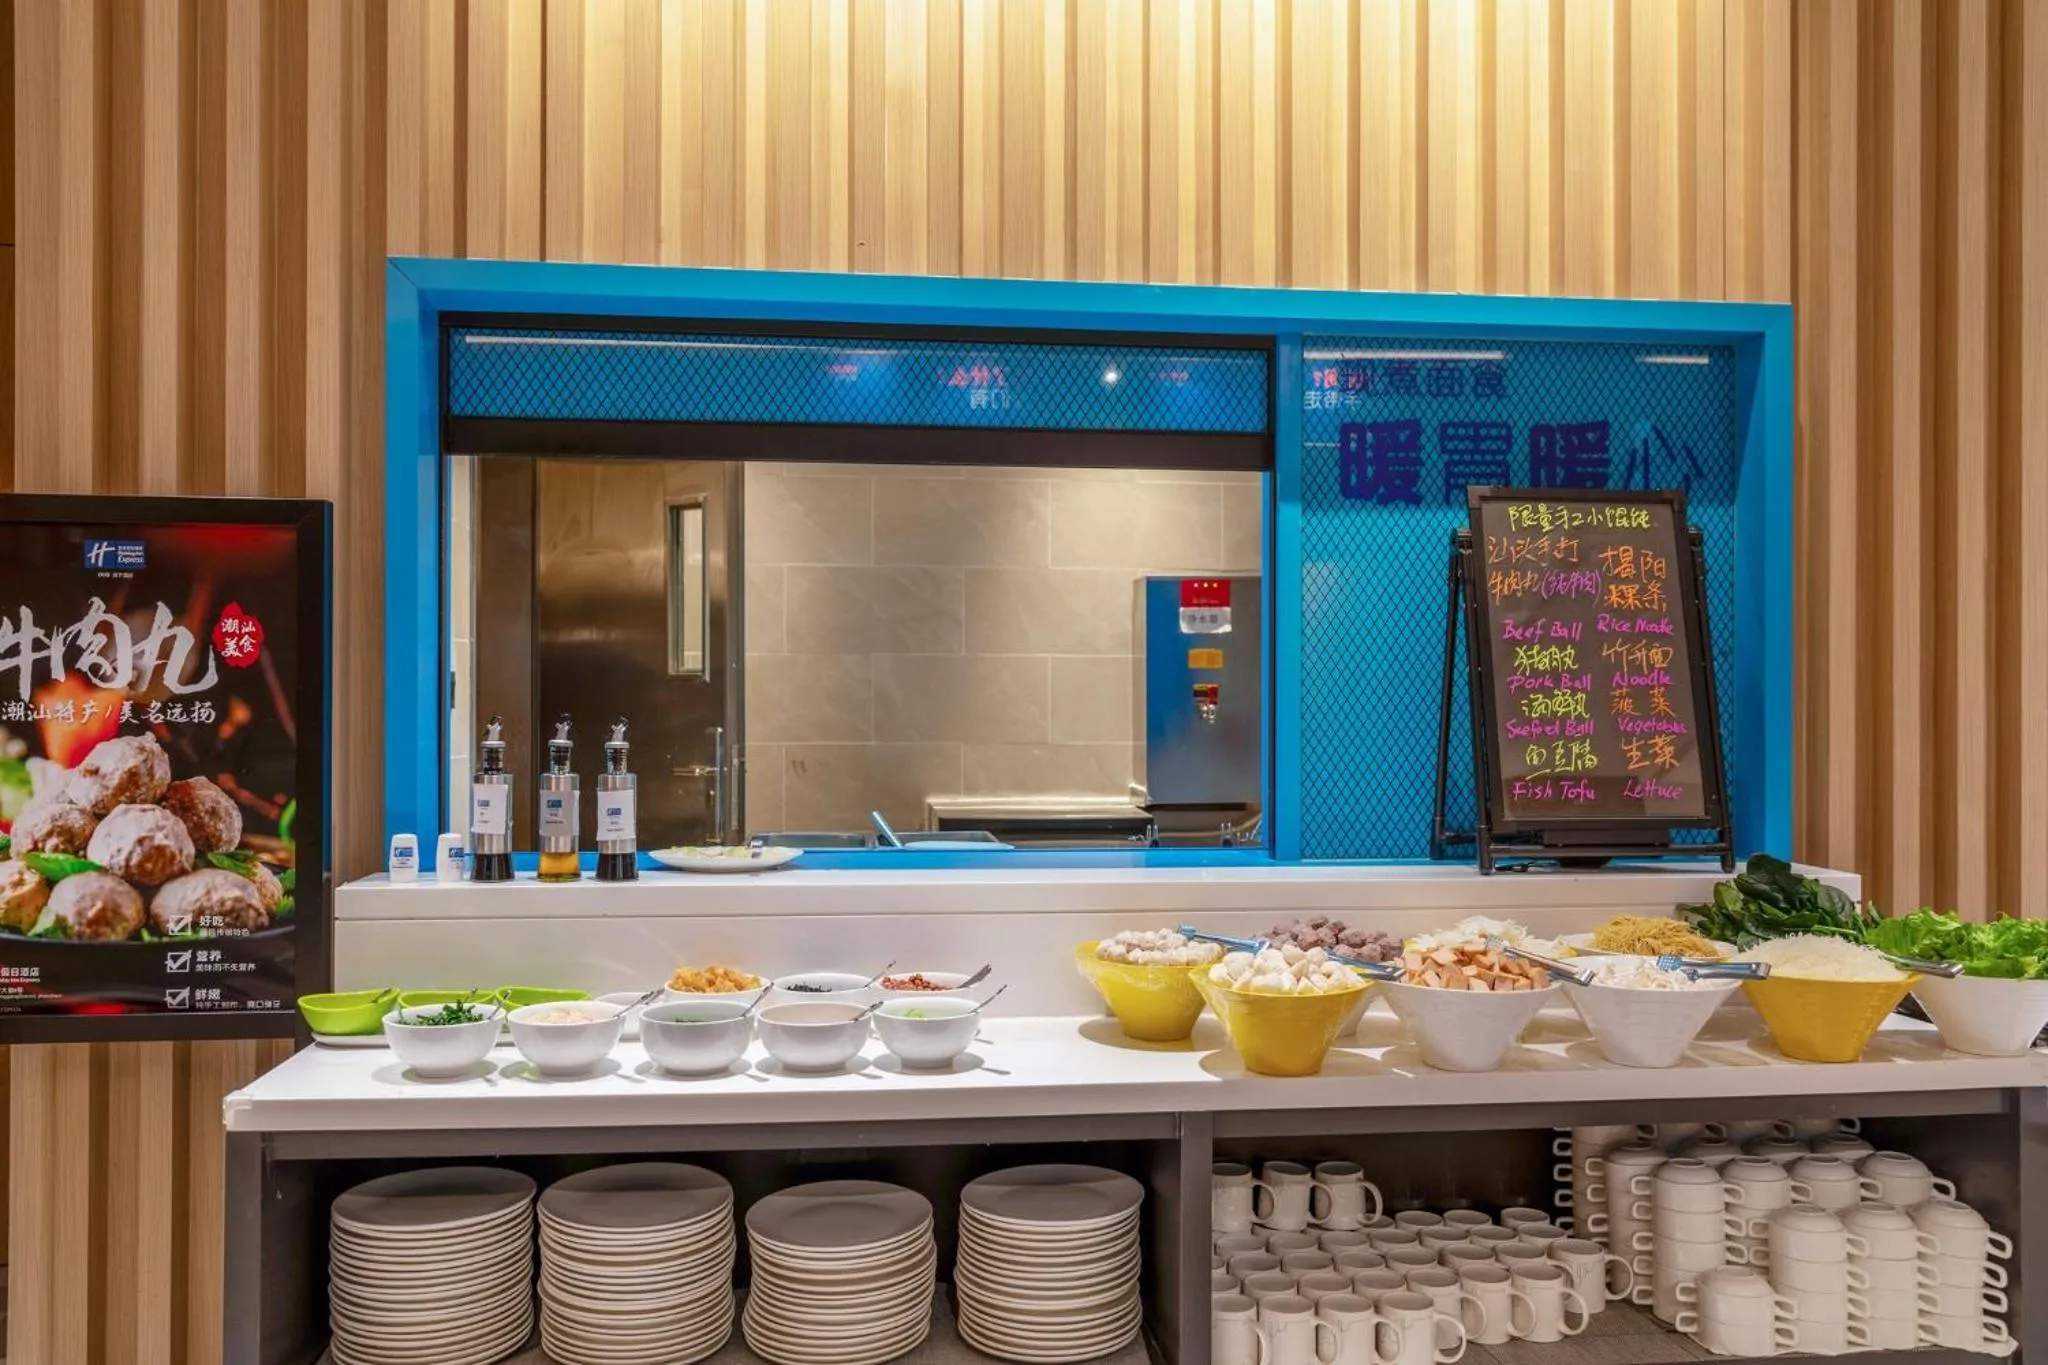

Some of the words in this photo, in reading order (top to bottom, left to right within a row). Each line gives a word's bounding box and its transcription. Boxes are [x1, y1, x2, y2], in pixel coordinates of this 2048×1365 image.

[1597, 545, 1667, 583] 揭阳
[221, 618, 256, 634] 潮汕
[1503, 618, 1545, 641] Beef
[1550, 621, 1583, 641] Ball
[1597, 613, 1631, 634] Rice
[1635, 618, 1675, 636] Noodle
[0, 597, 219, 704] 牛肉丸
[221, 635, 256, 657] 美食
[1507, 676, 1554, 694] Pork
[1561, 674, 1592, 690] Ball
[1612, 671, 1672, 686] Noodle
[1610, 687, 1676, 717] 菠菜
[1565, 720, 1594, 735] Ball
[1622, 735, 1679, 770] 生菜
[1513, 781, 1552, 801] Fish
[1560, 779, 1595, 800] Tofu
[1623, 777, 1683, 799] Lettuce
[199, 915, 224, 927] 好吃
[195, 950, 221, 962] 营养
[1, 967, 40, 977] 假日酒店
[195, 988, 221, 1000] 鲜嫩
